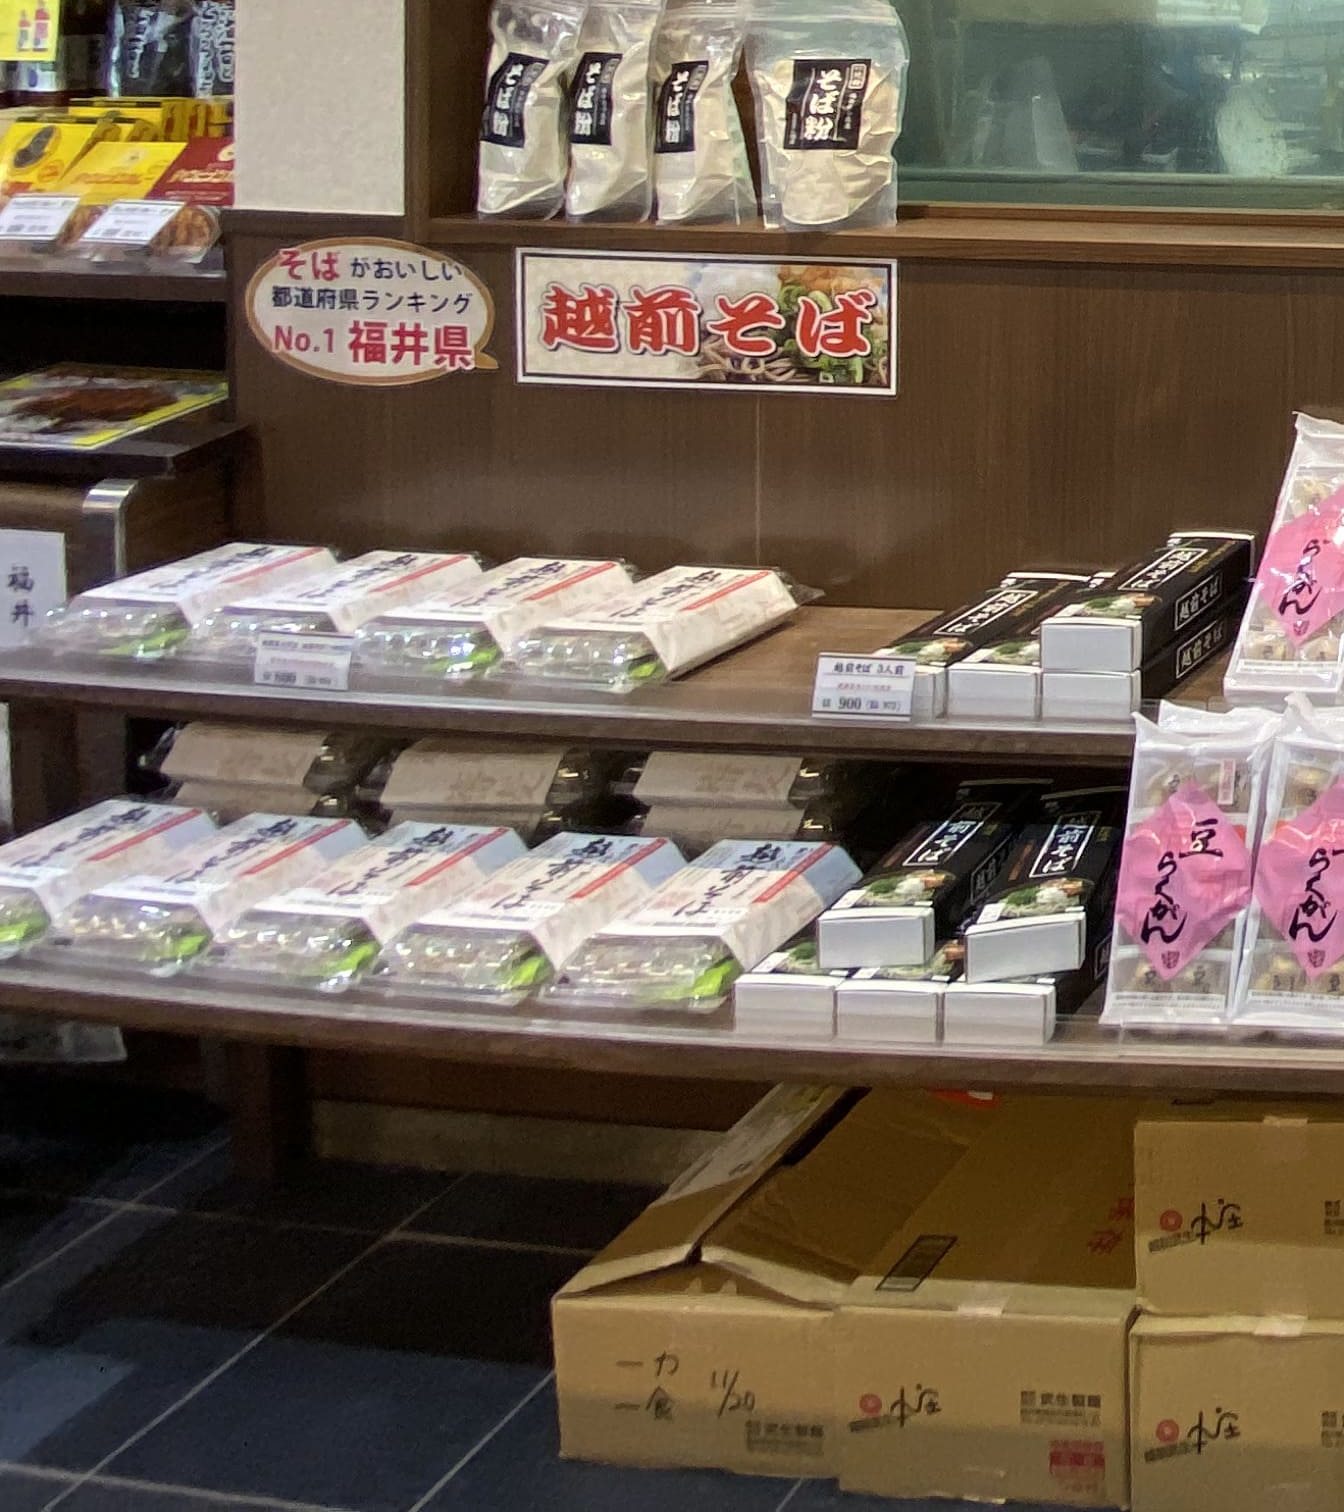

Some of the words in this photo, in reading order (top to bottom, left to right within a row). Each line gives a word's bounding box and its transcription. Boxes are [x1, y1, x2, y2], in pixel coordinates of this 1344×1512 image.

[805, 69, 842, 141] そば粉
[272, 286, 474, 315] 都道府県ランキング
[540, 284, 877, 358] 越前そば
[274, 326, 336, 356] No.1
[348, 321, 475, 369] 福井県
[838, 696, 862, 710] 900
[1141, 817, 1226, 947] 豆らくがん
